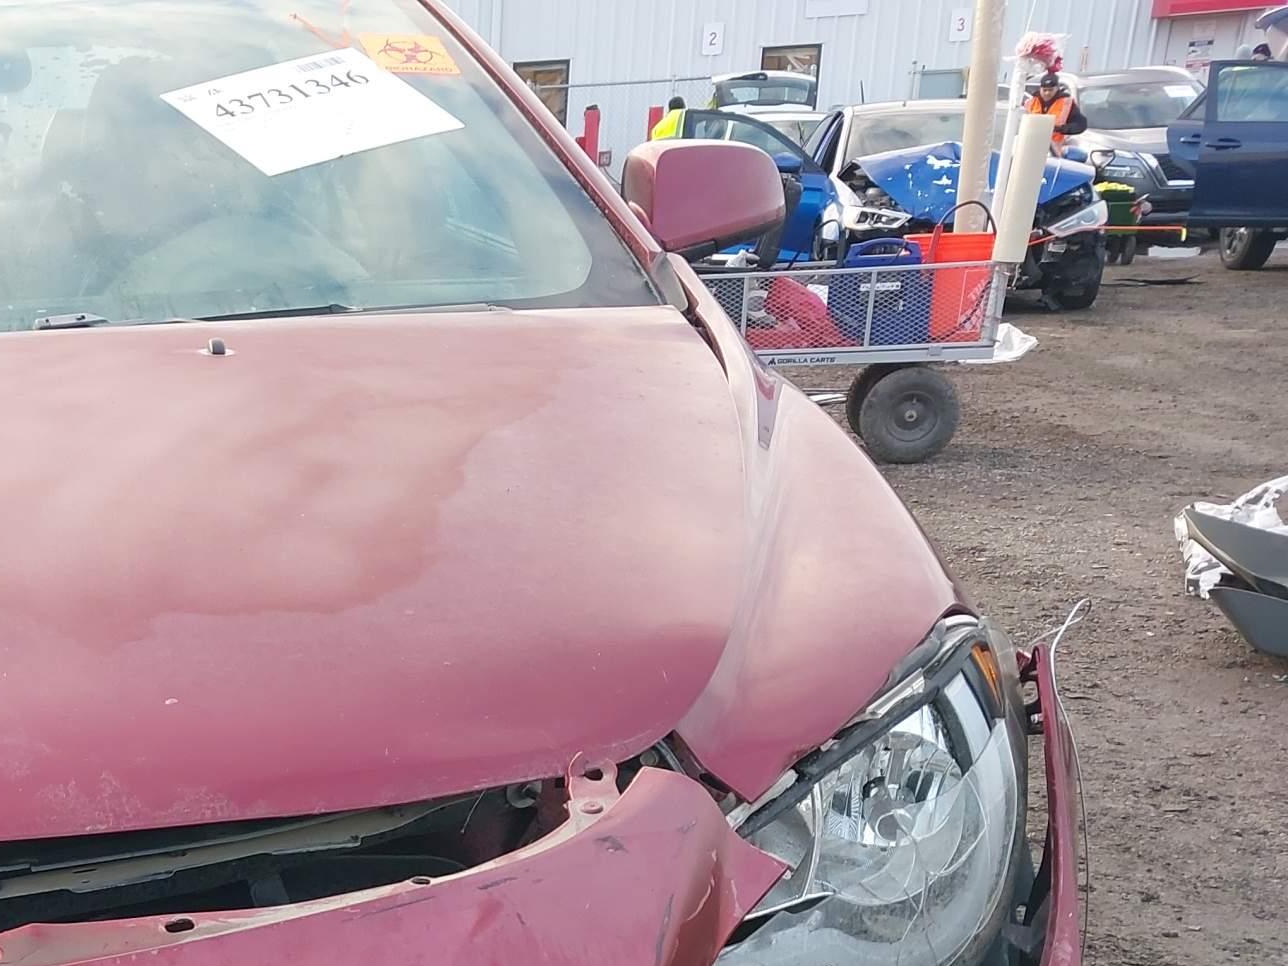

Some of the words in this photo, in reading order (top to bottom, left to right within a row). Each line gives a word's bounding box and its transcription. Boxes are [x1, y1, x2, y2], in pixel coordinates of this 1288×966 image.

[956, 17, 966, 32] 3
[708, 31, 718, 47] 2
[214, 69, 370, 119] 43731346
